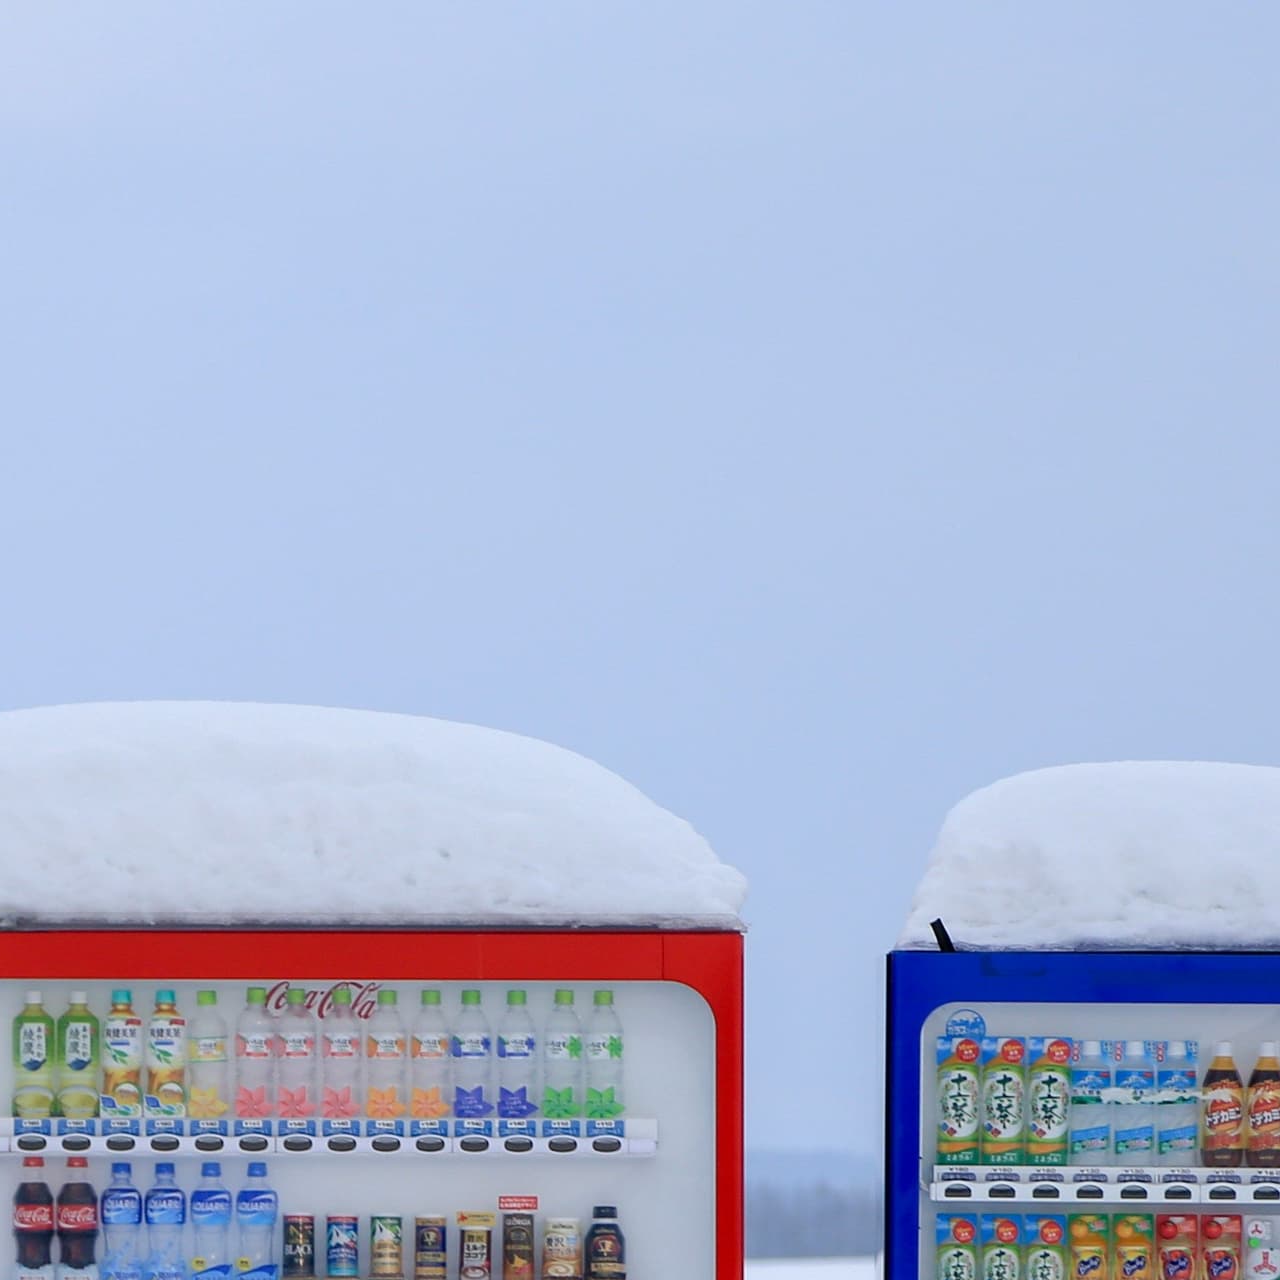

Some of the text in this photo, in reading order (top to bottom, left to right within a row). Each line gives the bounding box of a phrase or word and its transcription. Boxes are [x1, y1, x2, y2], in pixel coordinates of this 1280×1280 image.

[948, 1073, 972, 1129] 十六茶
[993, 1073, 1018, 1129] 十六茶
[1038, 1074, 1063, 1130] 十六茶
[285, 1244, 312, 1256] BLACK
